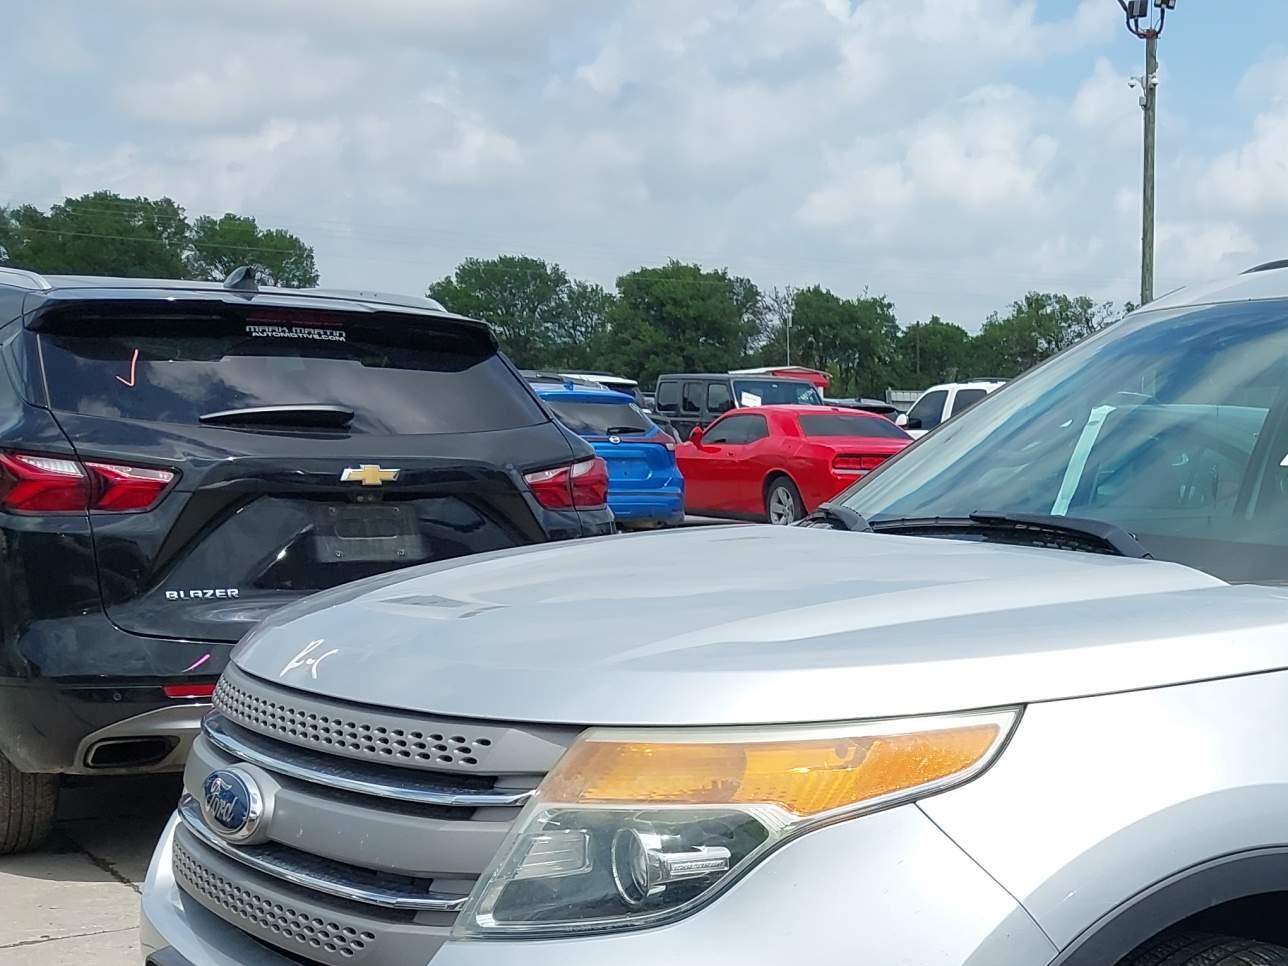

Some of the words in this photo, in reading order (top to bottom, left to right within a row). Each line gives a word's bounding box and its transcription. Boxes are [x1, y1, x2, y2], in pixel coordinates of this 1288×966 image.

[245, 325, 289, 333] MARK
[292, 327, 346, 338] MARTIN
[252, 332, 346, 342] AUTOMOTIVE.COM
[165, 588, 239, 600] BLAZER
[205, 777, 239, 822] Ford
